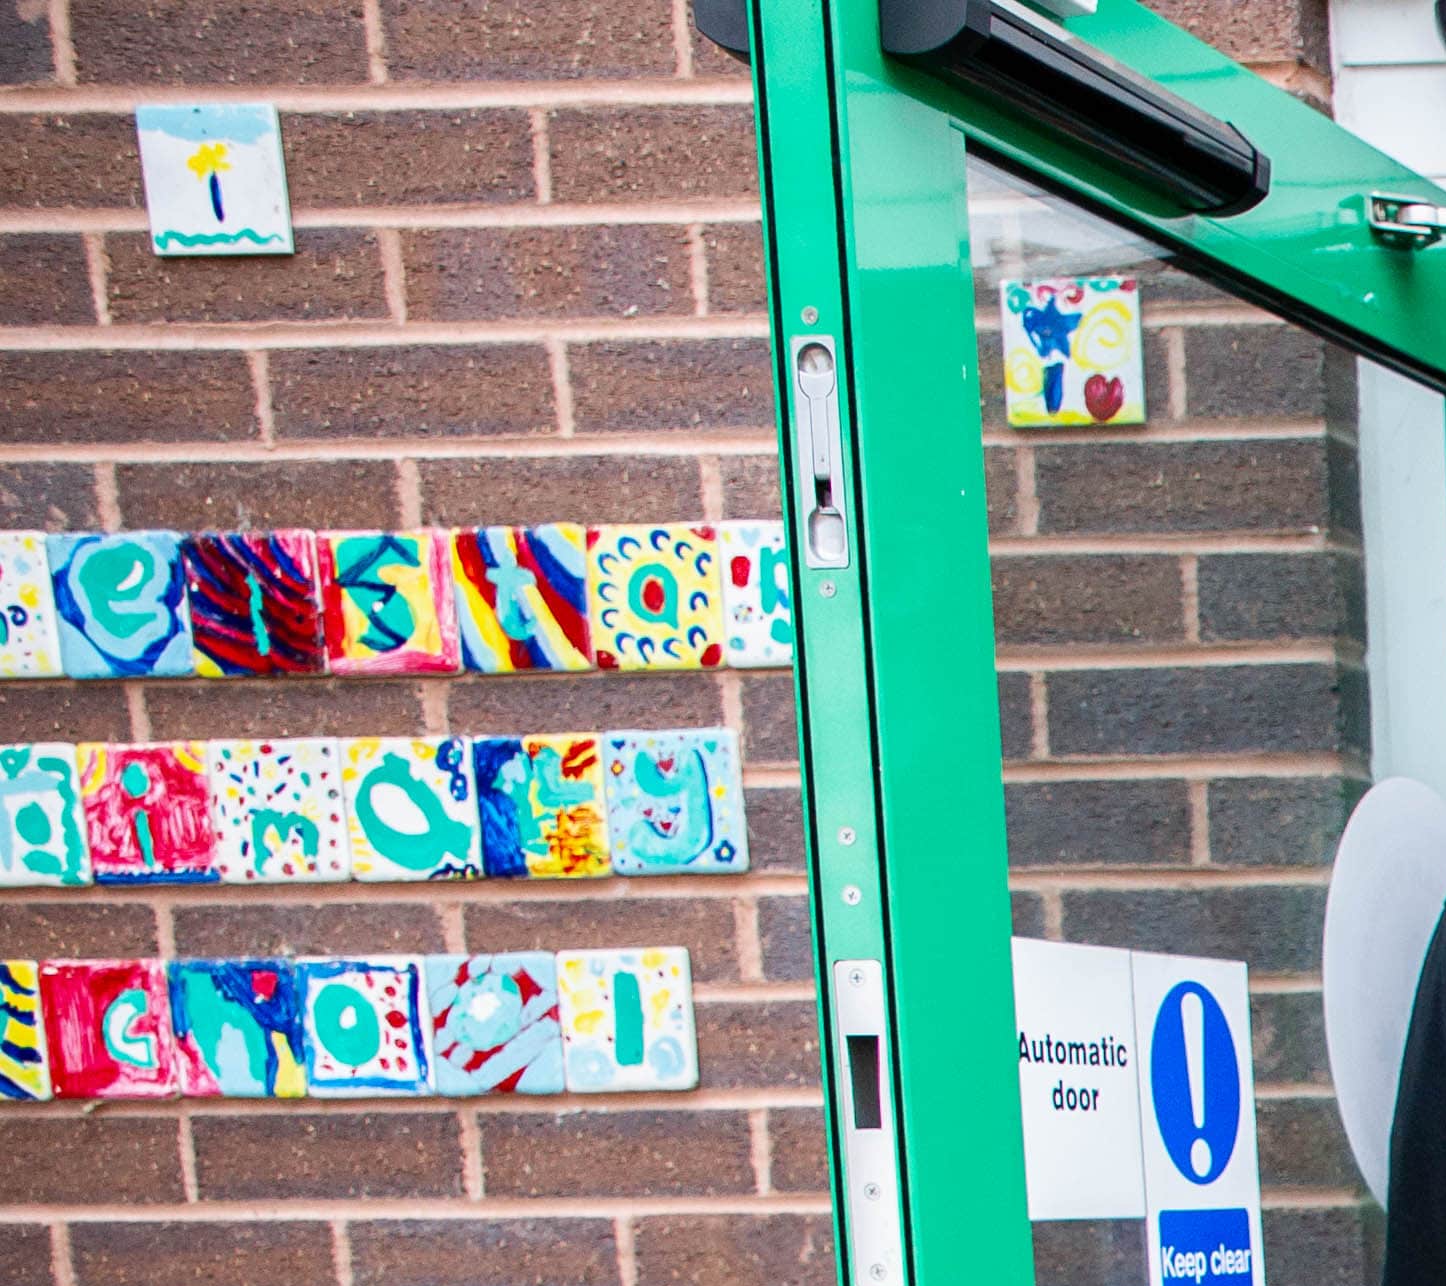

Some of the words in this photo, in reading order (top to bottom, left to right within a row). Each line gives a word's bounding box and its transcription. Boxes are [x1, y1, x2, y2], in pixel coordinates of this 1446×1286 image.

[0, 964, 644, 1094] chool
[1019, 1032, 1128, 1067] Automatic
[1052, 1081, 1099, 1111] door
[1162, 1246, 1206, 1284] Keep
[1210, 1243, 1251, 1276] clear
